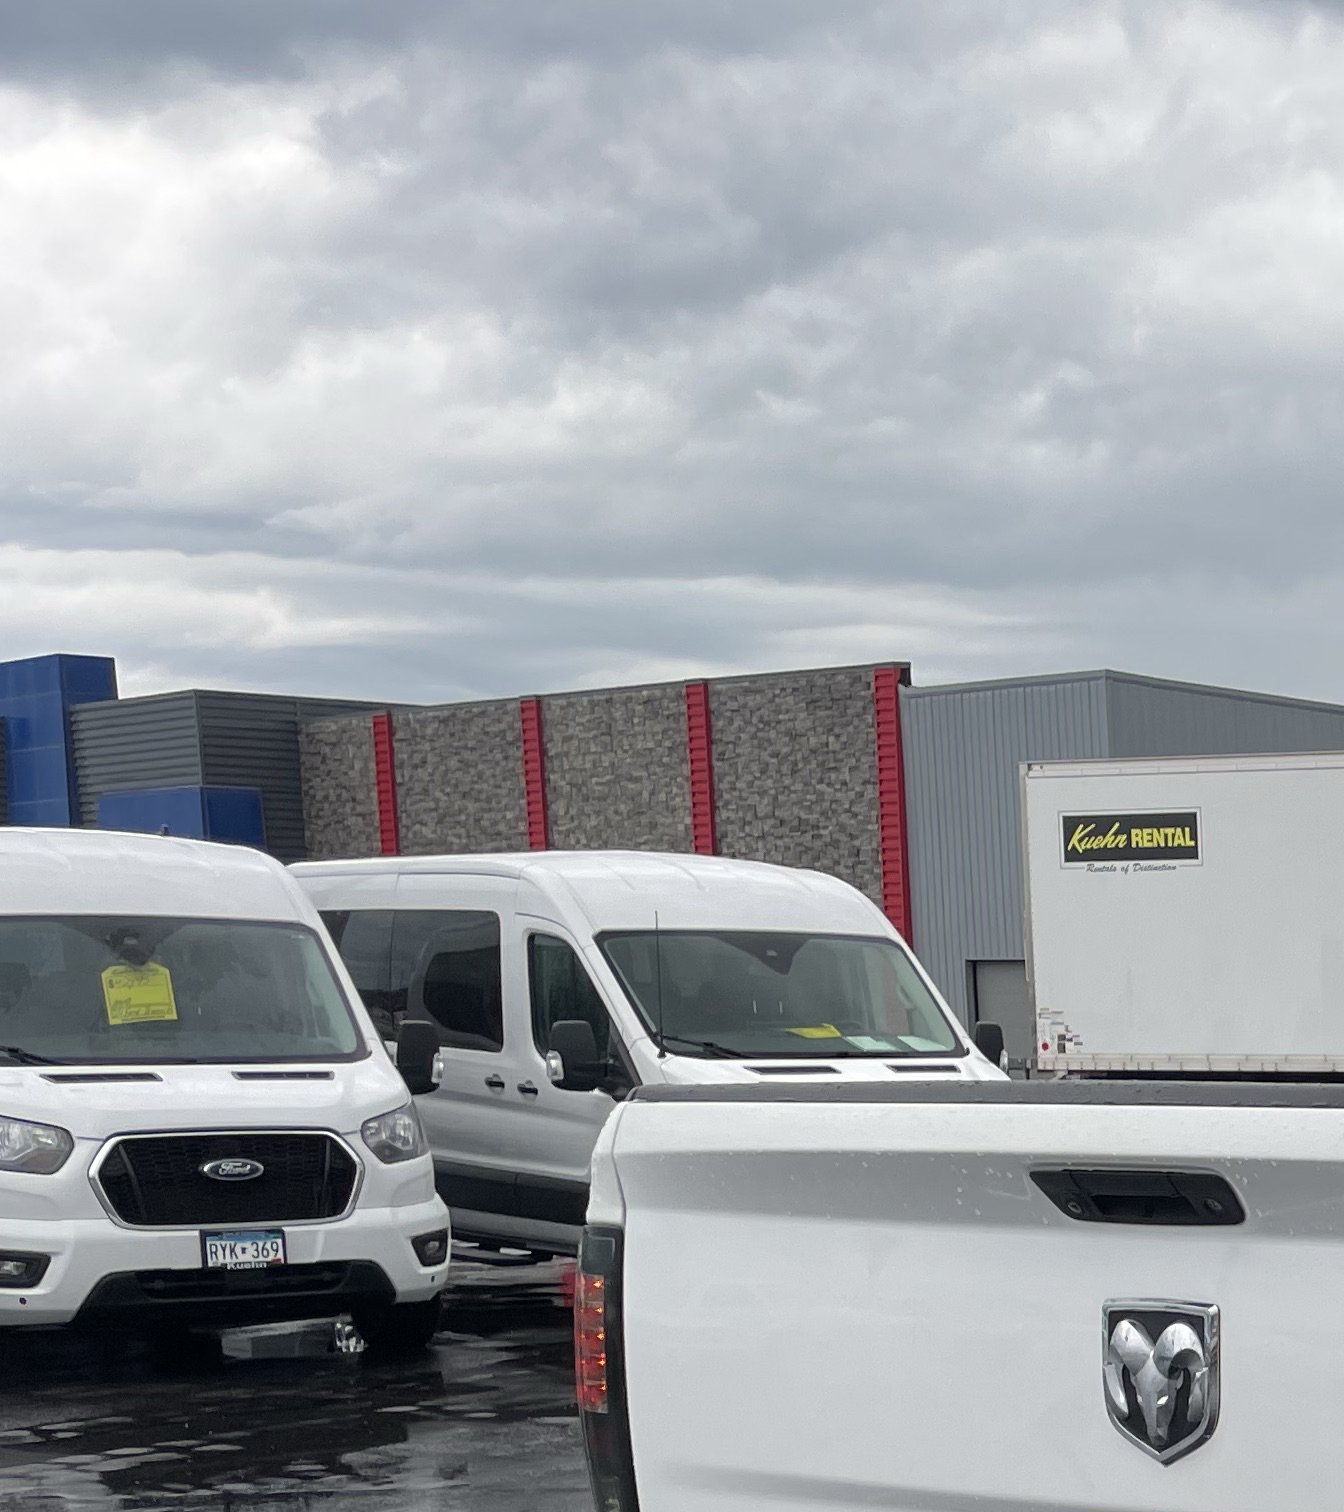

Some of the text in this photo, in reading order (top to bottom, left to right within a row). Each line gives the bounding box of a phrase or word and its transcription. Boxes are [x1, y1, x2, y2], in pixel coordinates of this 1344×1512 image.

[1067, 821, 1196, 854] Kuehn RENTAL
[1086, 863, 1177, 875] Rentals of Distinction
[209, 1240, 279, 1261] RYK 369
